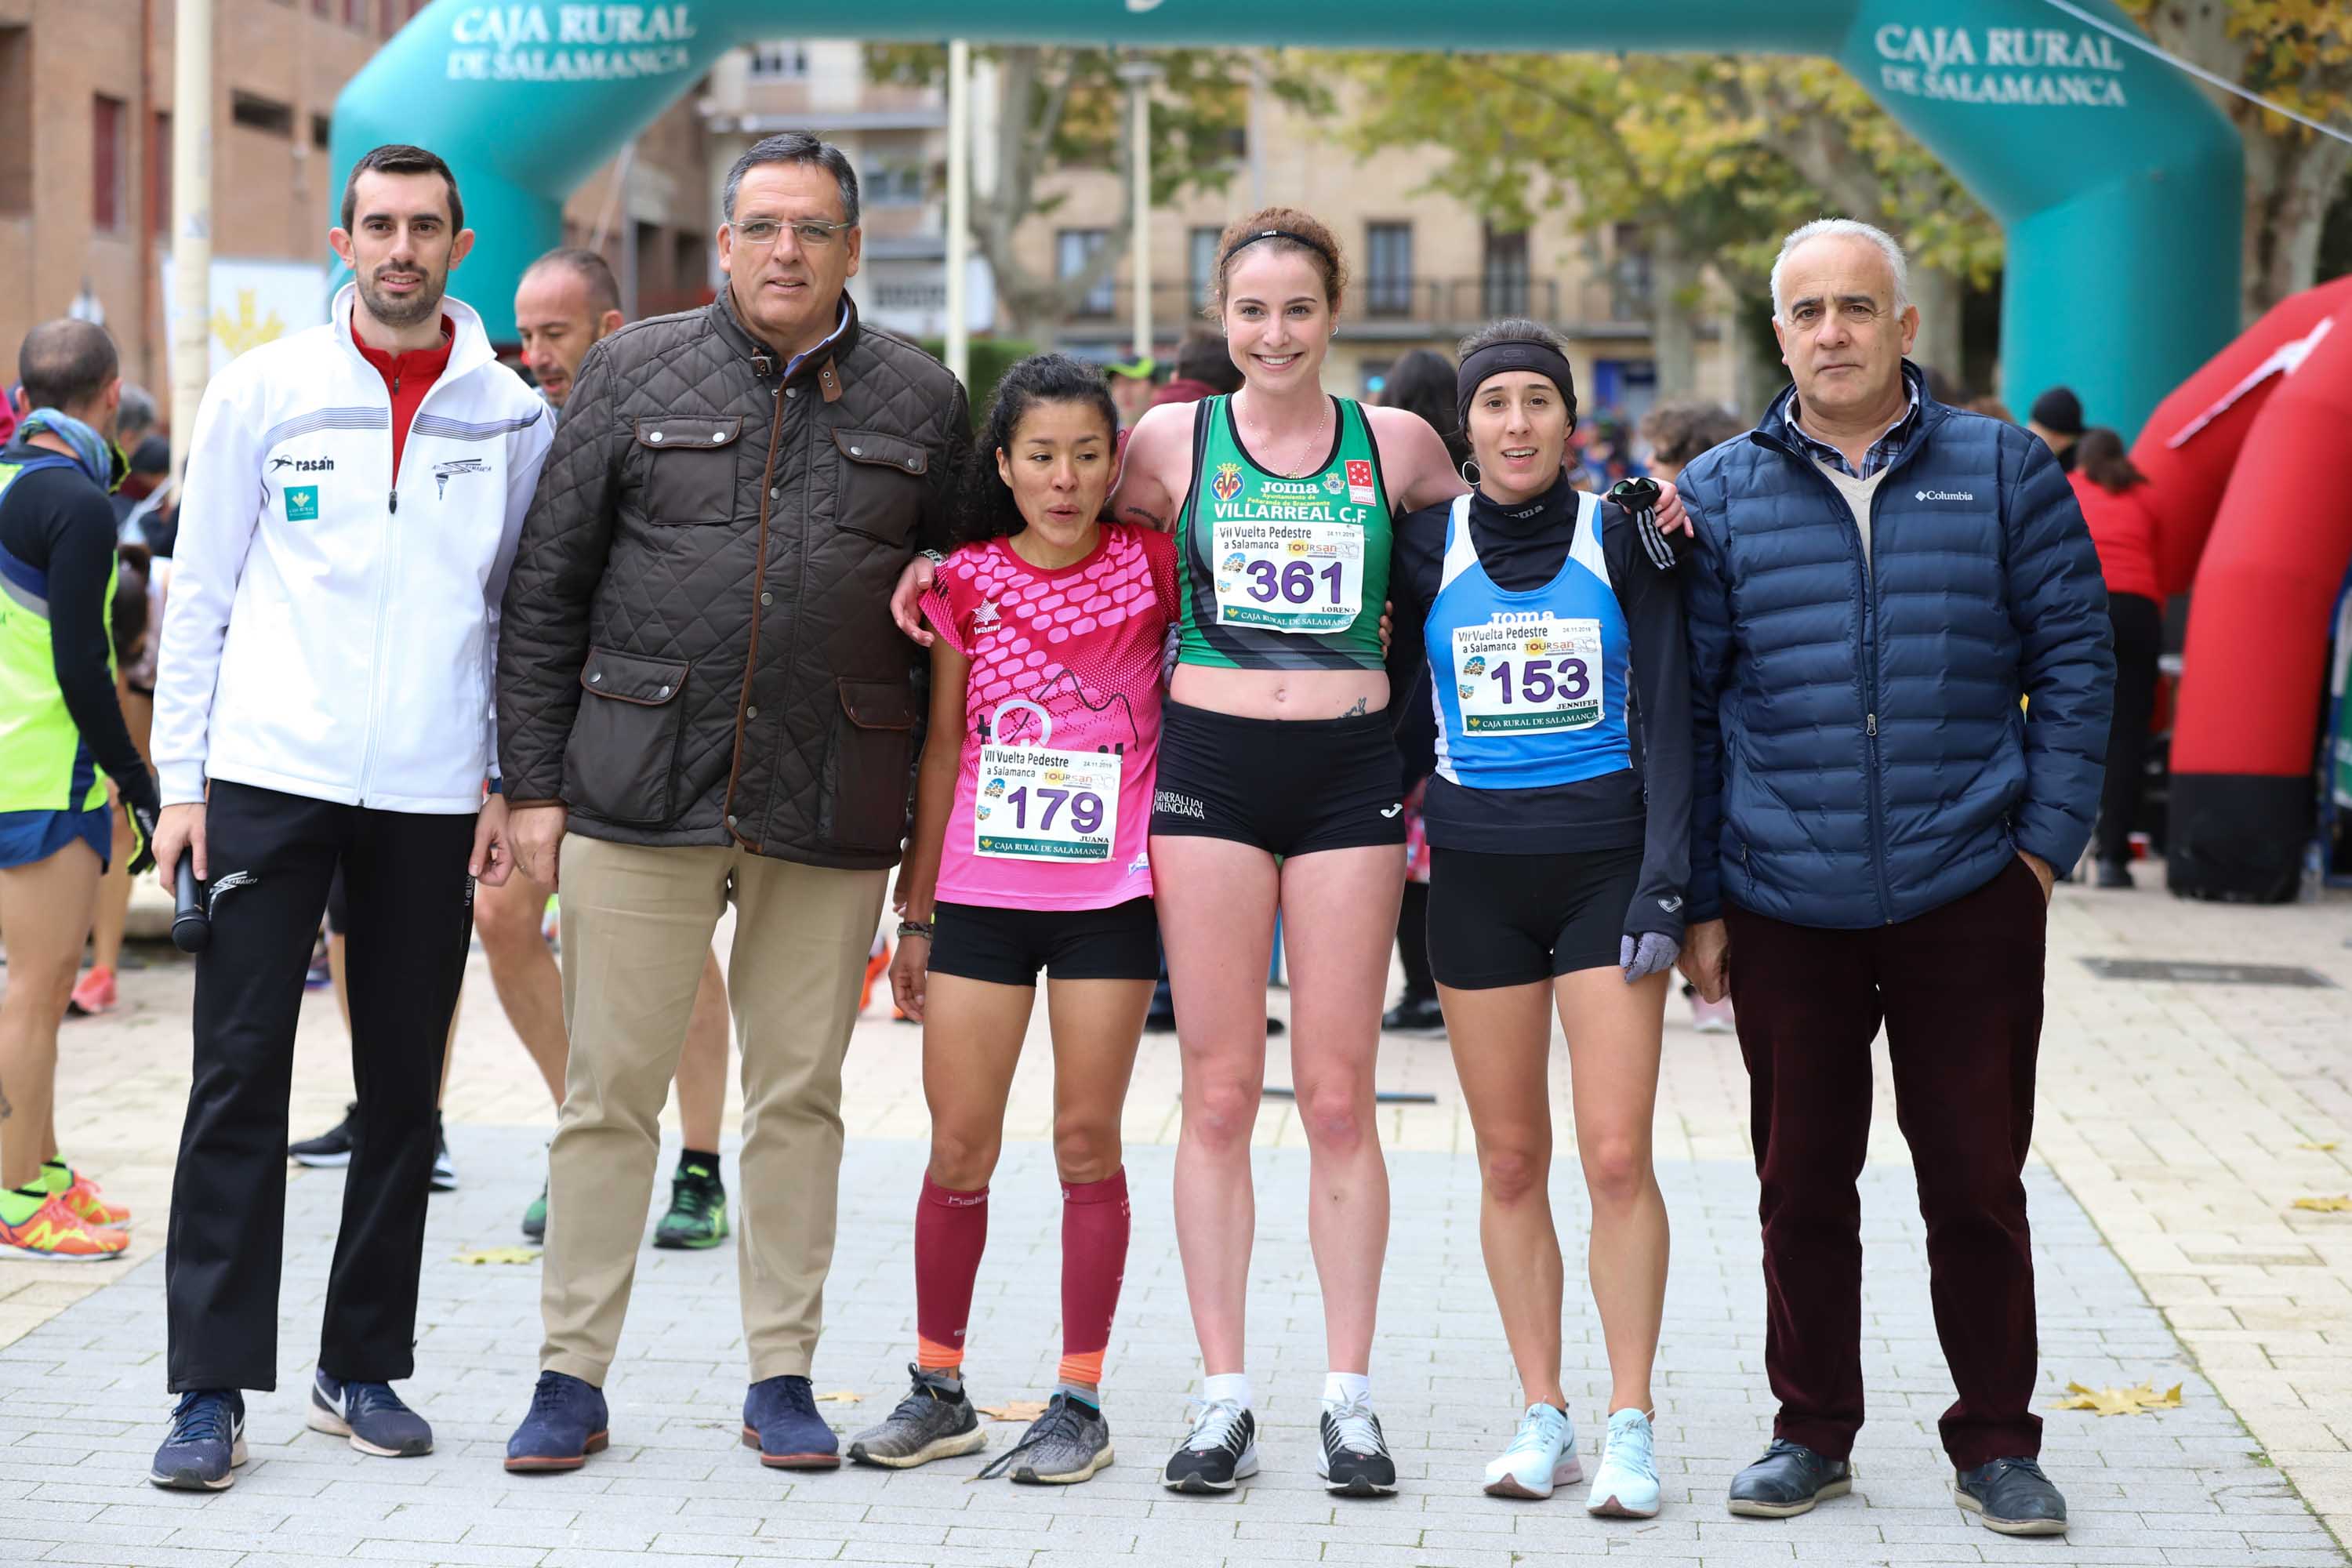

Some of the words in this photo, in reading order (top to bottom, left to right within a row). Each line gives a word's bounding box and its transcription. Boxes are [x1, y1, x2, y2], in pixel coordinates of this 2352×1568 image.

[452, 4, 549, 52] CAJA
[559, 4, 696, 43] RURAL
[1875, 23, 1977, 74] CAJA
[1986, 27, 2125, 71] RURAL
[447, 47, 488, 79] DE
[492, 45, 690, 81] SALAMANCA
[1879, 64, 1918, 96] DE
[1922, 71, 2127, 107] SALAMANCA
[296, 456, 334, 471] rasán
[1926, 490, 1973, 501] Columbia
[1214, 503, 1336, 521] VILLARREAL
[1234, 527, 1265, 539] Vuelta
[1269, 526, 1312, 539] Pedestre
[1232, 539, 1279, 550] Salamanca
[1247, 560, 1342, 604] 361
[1241, 612, 1261, 621] CAJA
[1262, 615, 1287, 625] RURAL
[1472, 628, 1503, 641] Vuelta
[1506, 626, 1548, 639] Pedestre
[1470, 642, 1516, 653] Salamanca
[1491, 658, 1590, 704] 153
[1557, 699, 1599, 710] JENNIFER
[1483, 720, 1501, 730] CAJA
[1503, 719, 1530, 728] RURAL
[1545, 712, 1598, 725] SALAMANCA
[985, 750, 995, 763] VII
[997, 750, 1025, 764] Vuelta
[1028, 753, 1069, 768] Pedestre
[993, 766, 1036, 778] Salamanca
[1007, 786, 1104, 834] 179
[1156, 801, 1205, 820] VALENCIANA
[994, 842, 1013, 851] CAJA
[1014, 843, 1039, 852] RURAL
[1040, 844, 1052, 853] DE
[1054, 846, 1106, 856] SALAMANCA
